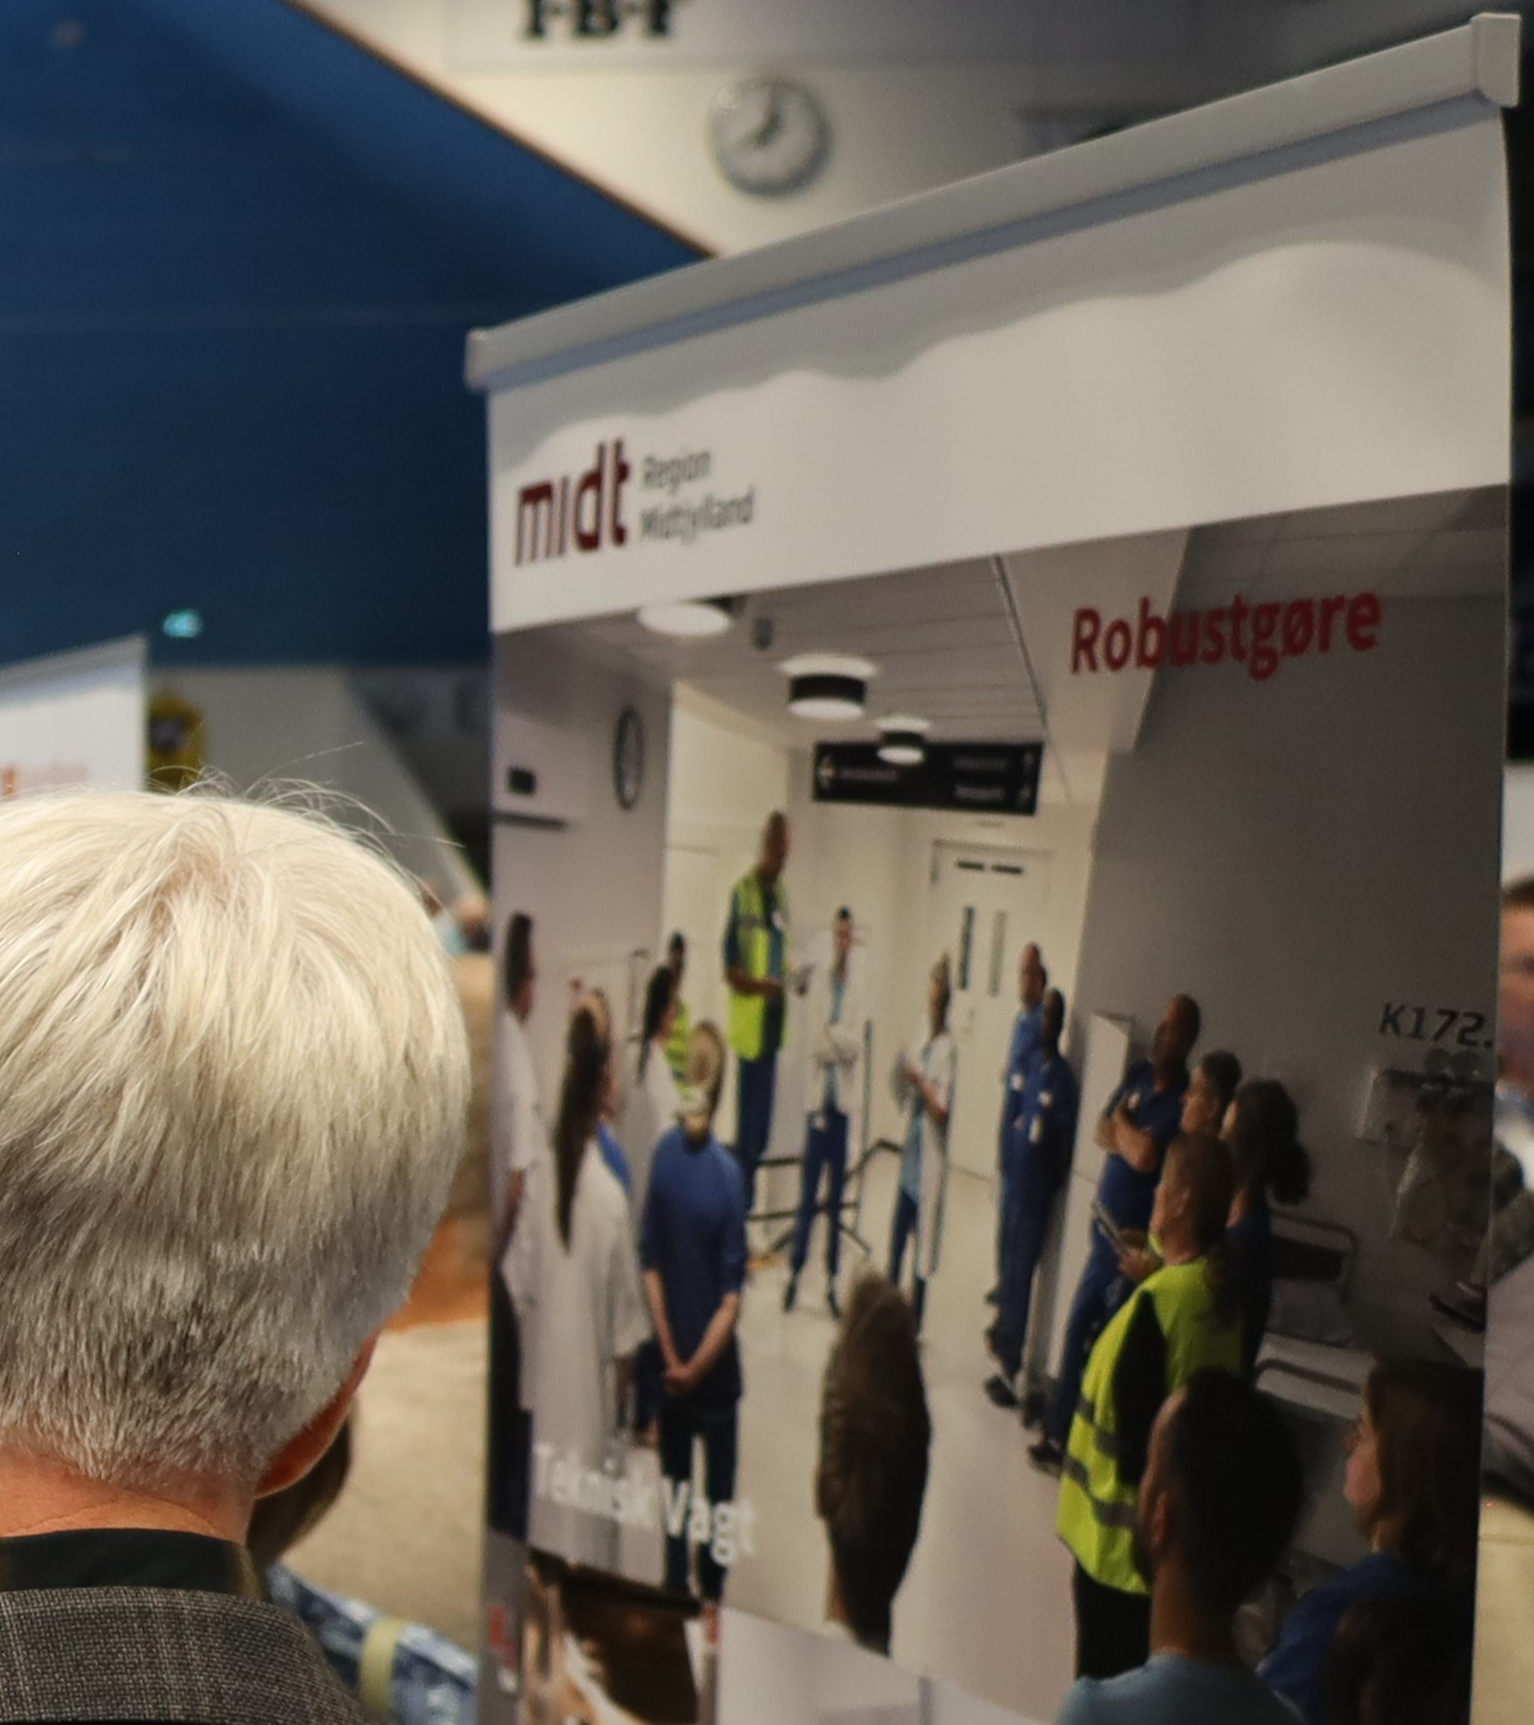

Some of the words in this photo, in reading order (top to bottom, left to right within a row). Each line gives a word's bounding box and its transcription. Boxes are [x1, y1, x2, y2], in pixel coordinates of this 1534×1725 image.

[514, 437, 631, 568] midt
[640, 483, 755, 546] Midtjylland
[642, 448, 712, 496] Region
[1070, 590, 1383, 683] Robustgøre
[532, 1443, 660, 1528] Teknisk
[661, 1472, 756, 1567] Vagt
